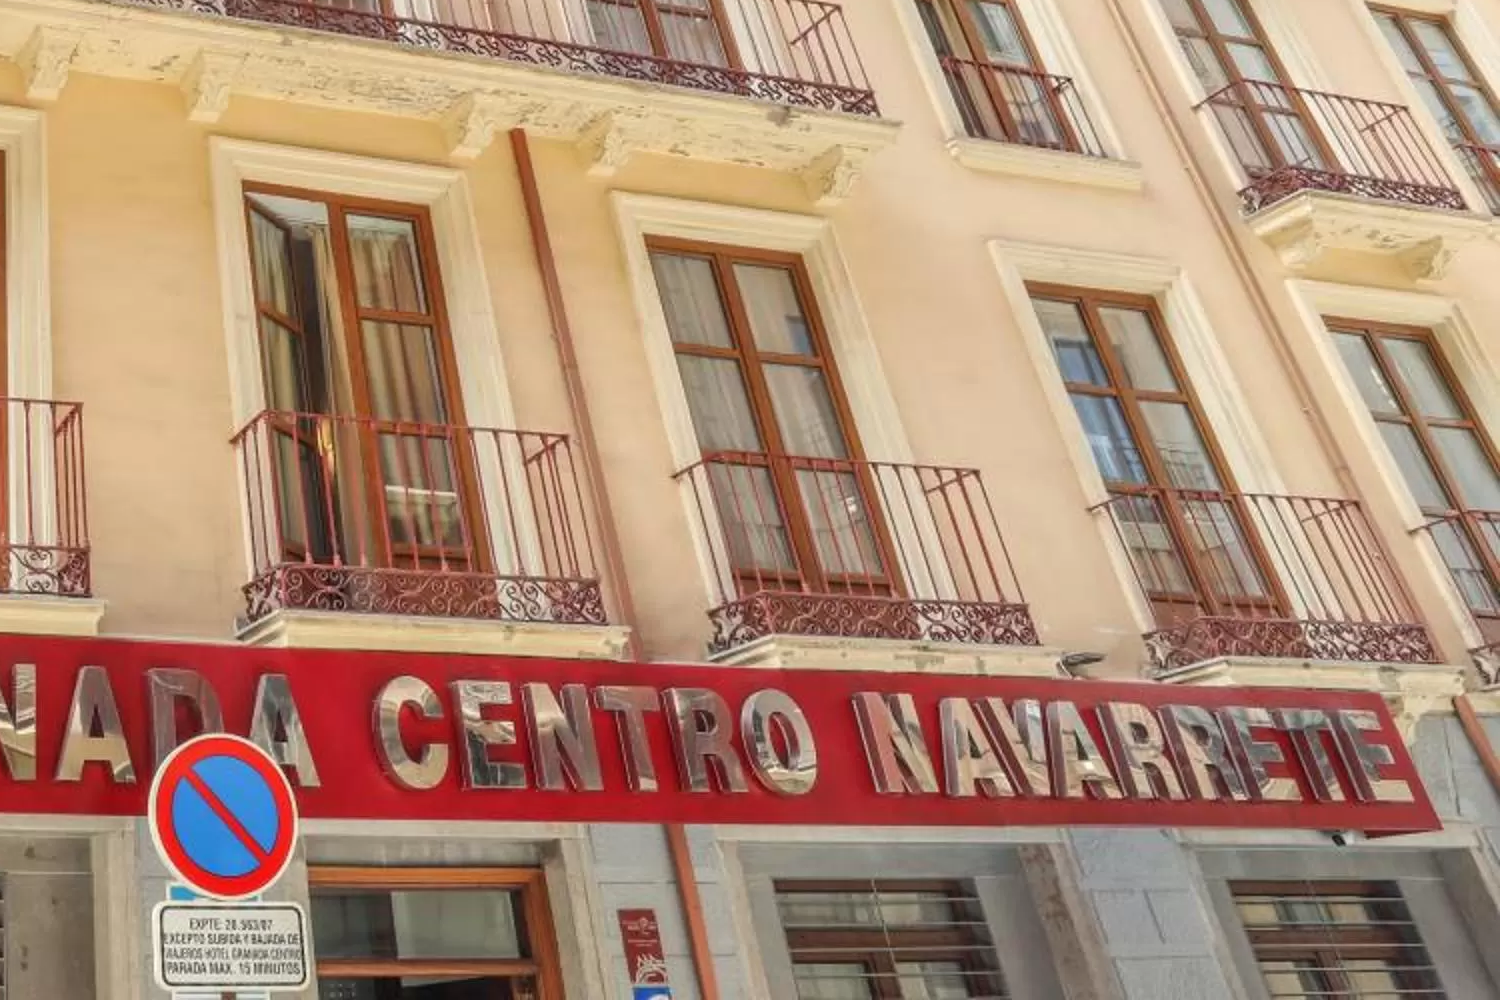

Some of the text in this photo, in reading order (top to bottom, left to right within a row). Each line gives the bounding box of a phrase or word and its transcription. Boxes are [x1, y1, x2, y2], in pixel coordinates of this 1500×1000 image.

[371, 675, 820, 795] CENTRO
[851, 692, 1416, 804] NAVARRETE
[163, 933, 300, 945] EXCEPTO SUBIDA Y BAJADA DE
[205, 948, 229, 960] HOTEL
[231, 948, 269, 960] GRANADA
[270, 948, 301, 960] CENTRO
[166, 961, 207, 974] PARADA
[239, 962, 251, 974] 15
[253, 962, 301, 975] MINUTOS
